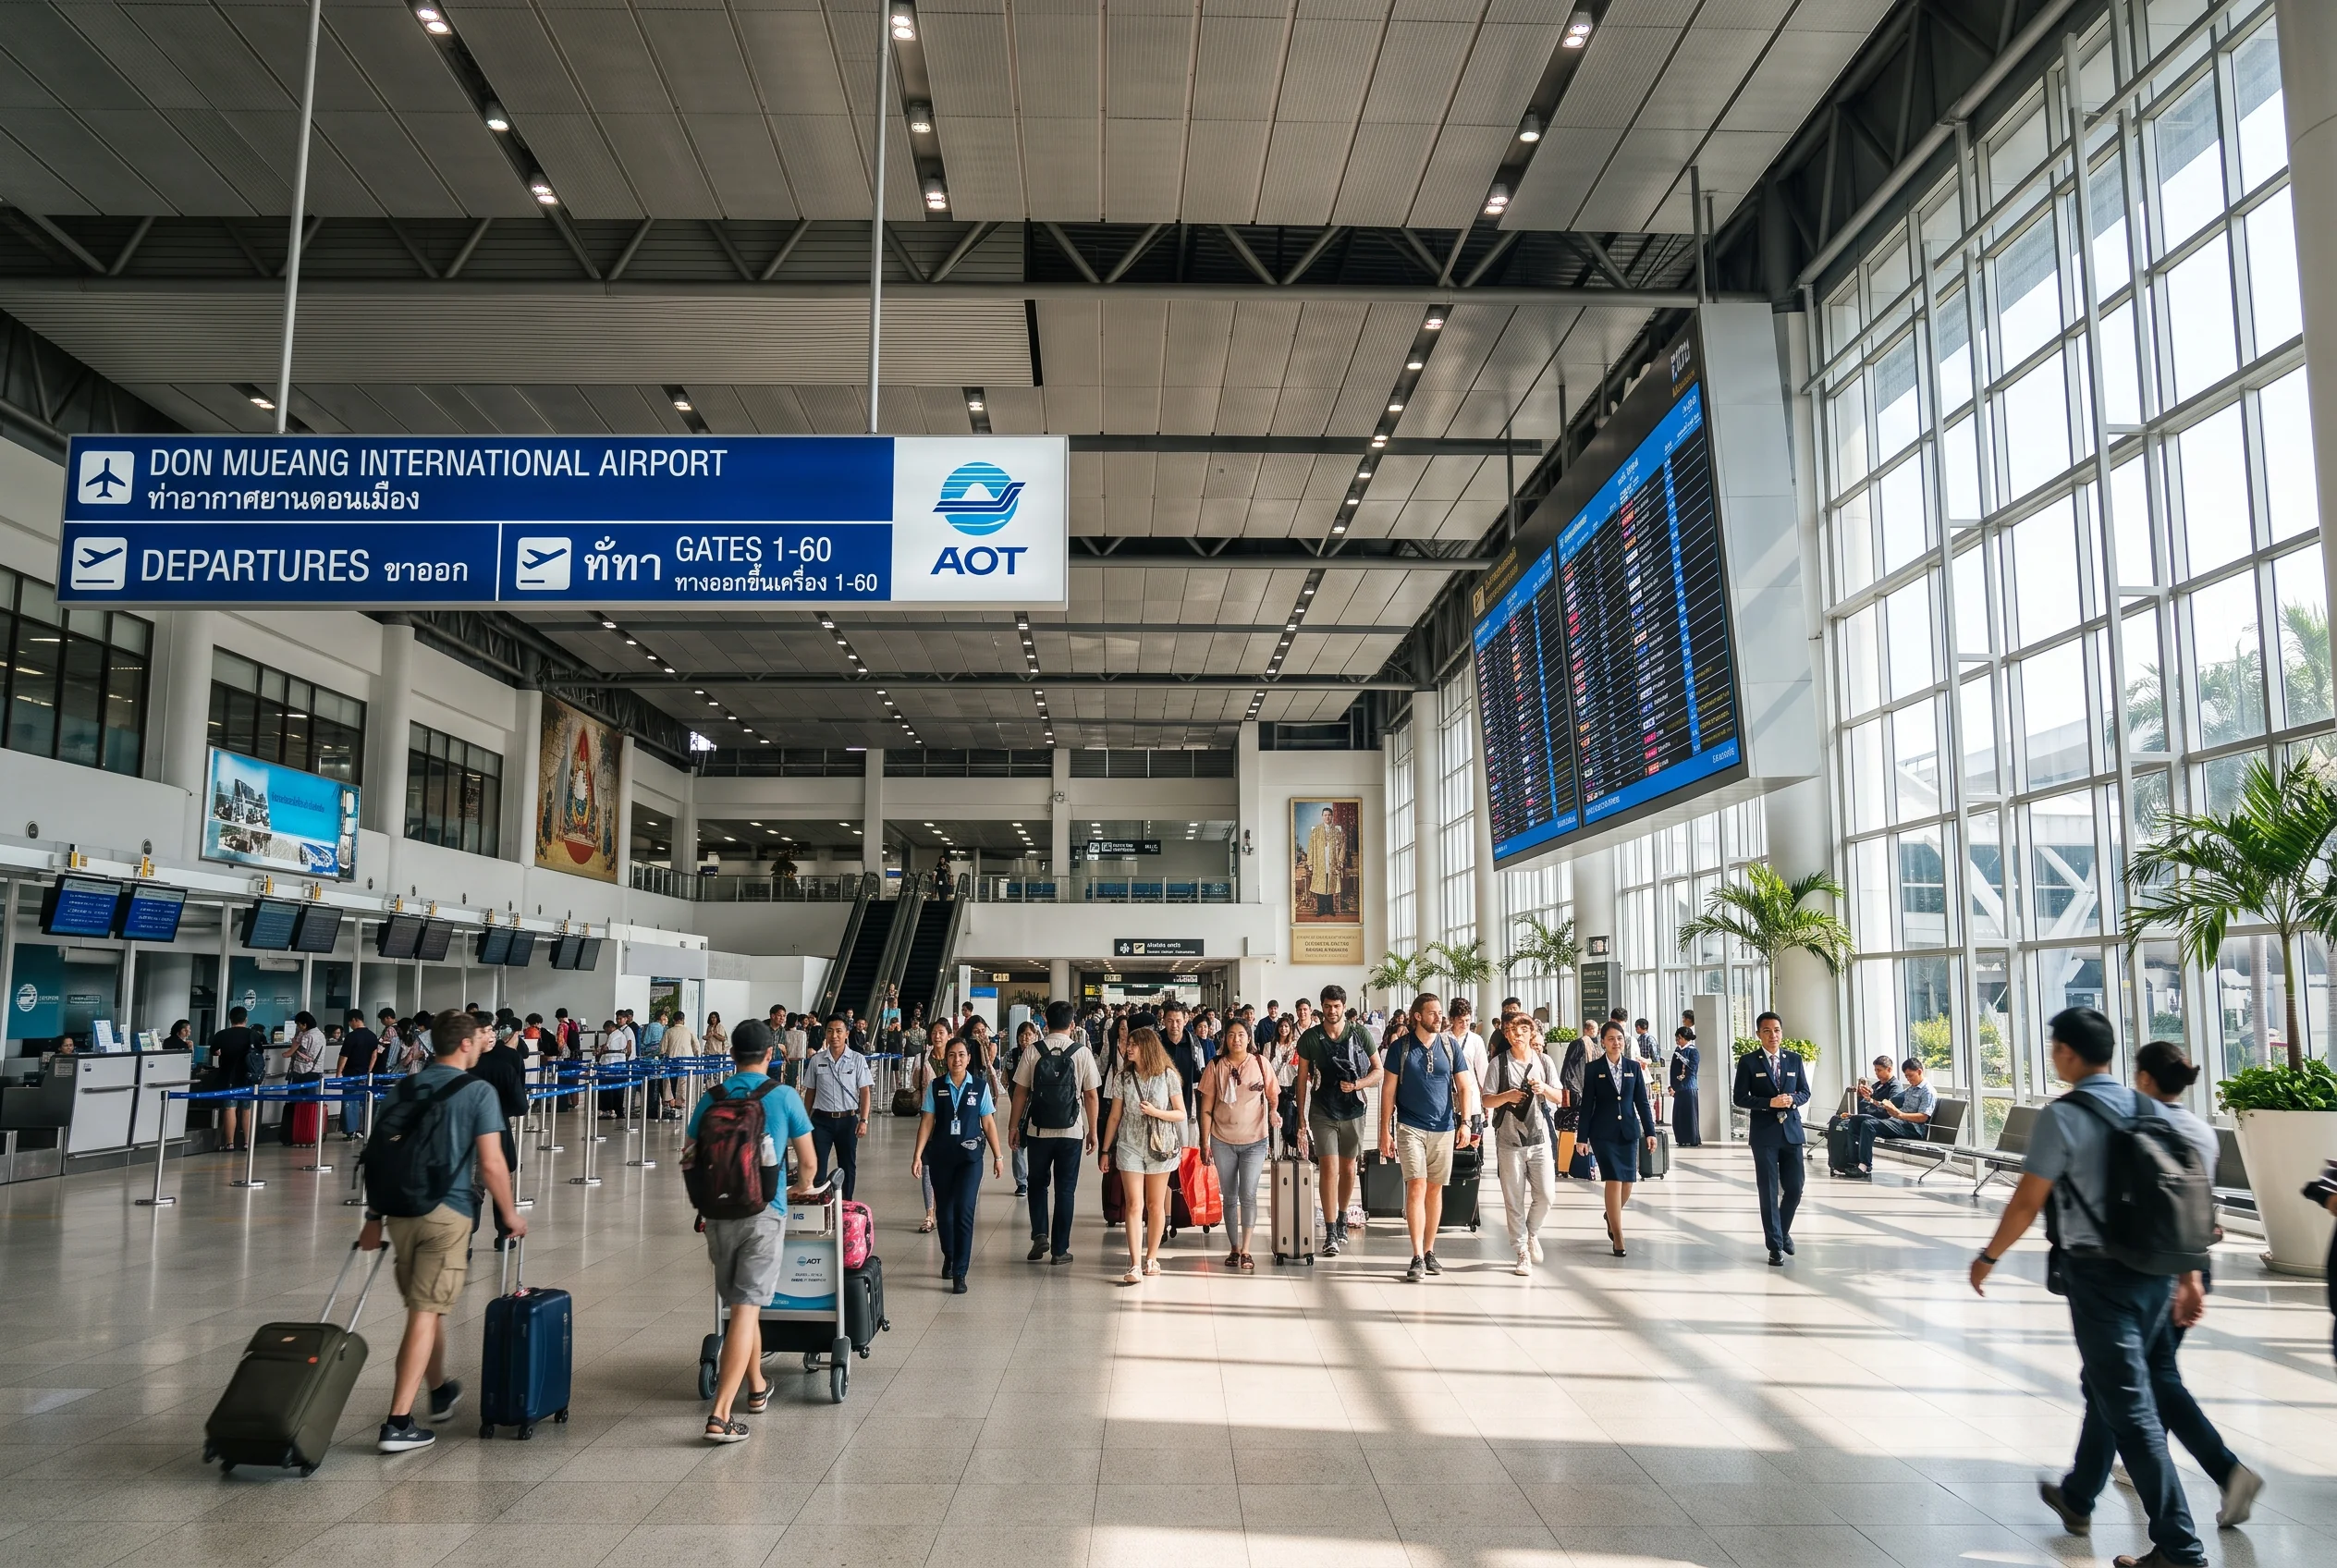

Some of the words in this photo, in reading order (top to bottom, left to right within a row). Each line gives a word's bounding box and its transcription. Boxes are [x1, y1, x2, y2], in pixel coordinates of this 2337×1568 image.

[149, 448, 213, 476] DON
[222, 448, 349, 477] MUEANG
[360, 448, 590, 477] INTERNATIONAL
[598, 448, 728, 477] AIRPORT
[147, 480, 421, 510] ท่าอากาศยานดอนเมือง
[676, 535, 763, 562] GATES
[772, 535, 832, 562] 1-60
[930, 545, 1029, 576] AOT
[141, 548, 370, 582] DEPARTURES
[384, 562, 468, 582] ขาออก
[835, 573, 878, 592] 1-60
